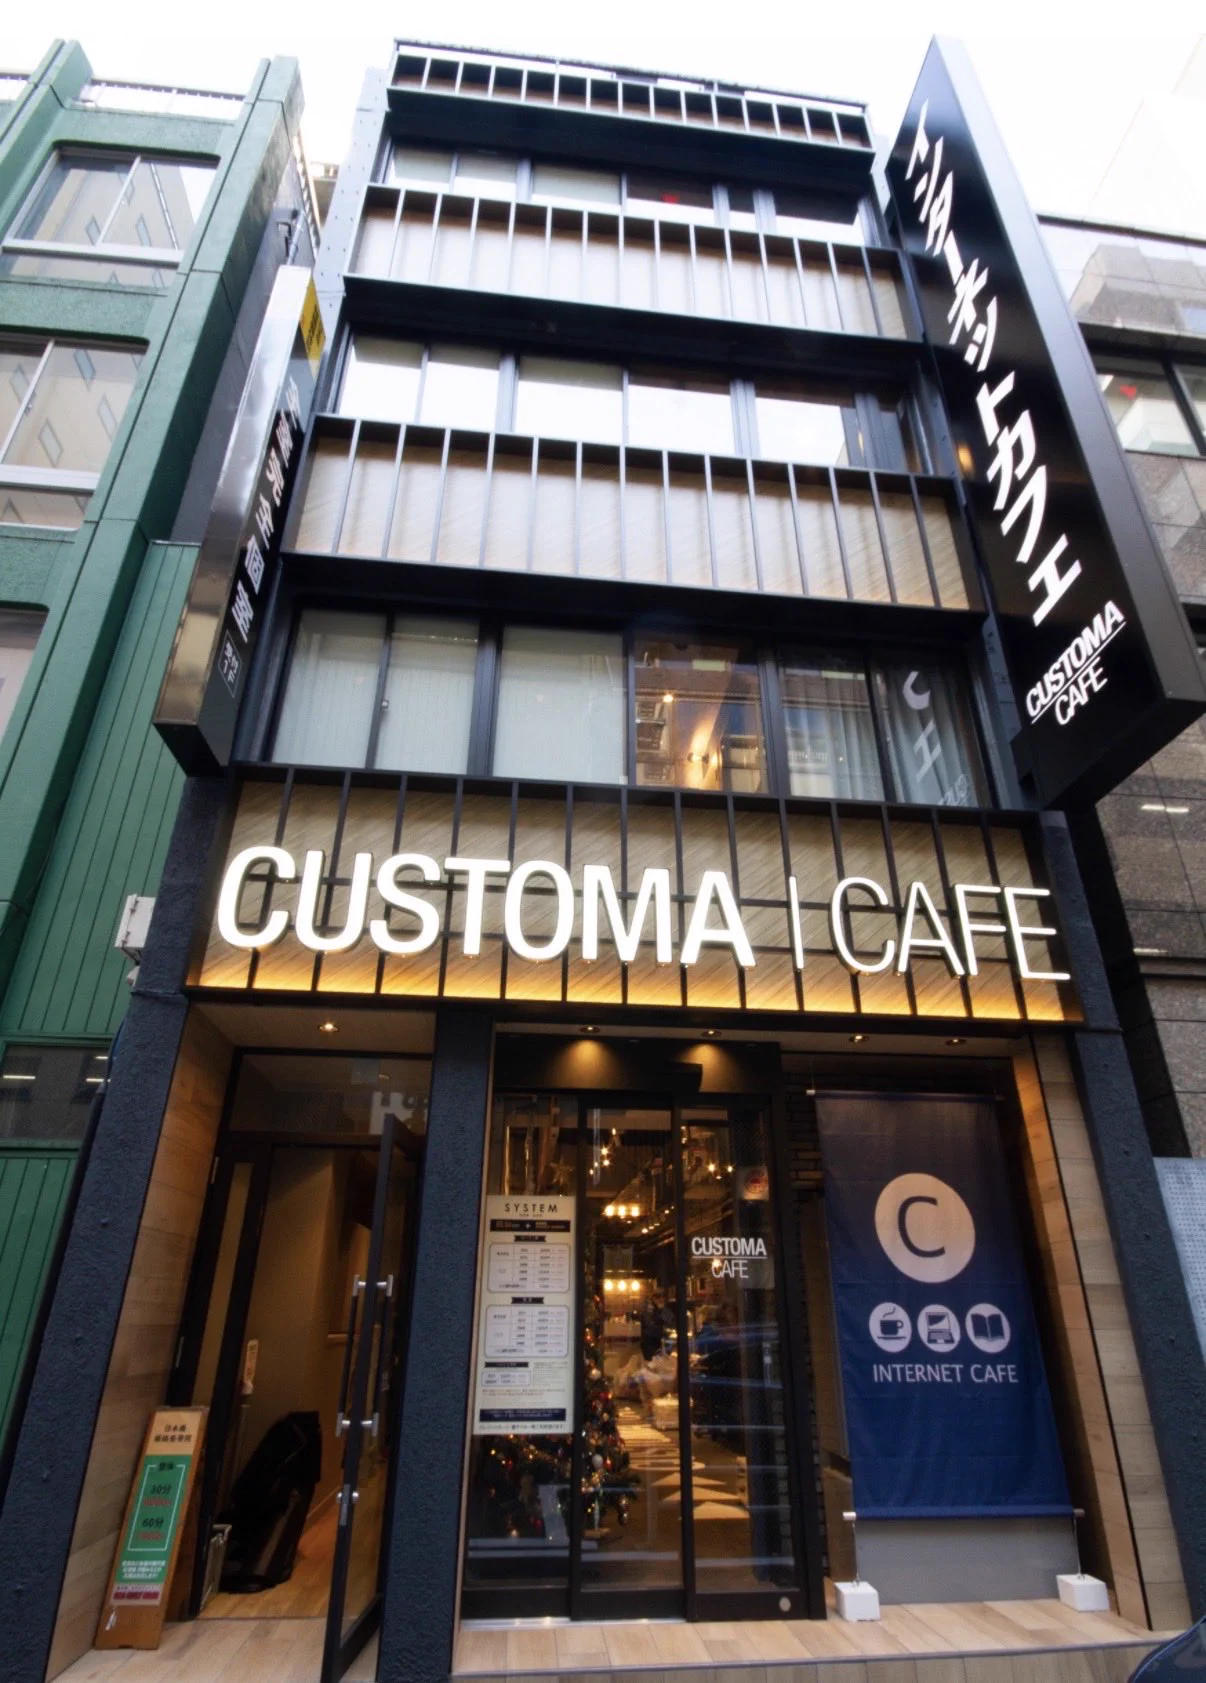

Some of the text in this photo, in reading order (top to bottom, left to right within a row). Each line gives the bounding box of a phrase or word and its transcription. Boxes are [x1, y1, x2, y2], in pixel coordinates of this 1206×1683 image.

[904, 98, 1082, 627] インターネットカフェ
[1026, 600, 1125, 718] CUSTOMA
[1055, 656, 1108, 726] CAFE
[217, 845, 1072, 981] CUSTOMA CAFE
[504, 1202, 558, 1213] SYSTEM
[897, 1195, 947, 1259] C
[691, 1236, 768, 1256] CUSTOMA
[711, 1259, 750, 1279] CAFE
[872, 1363, 1019, 1384] INTERNET CAFE
